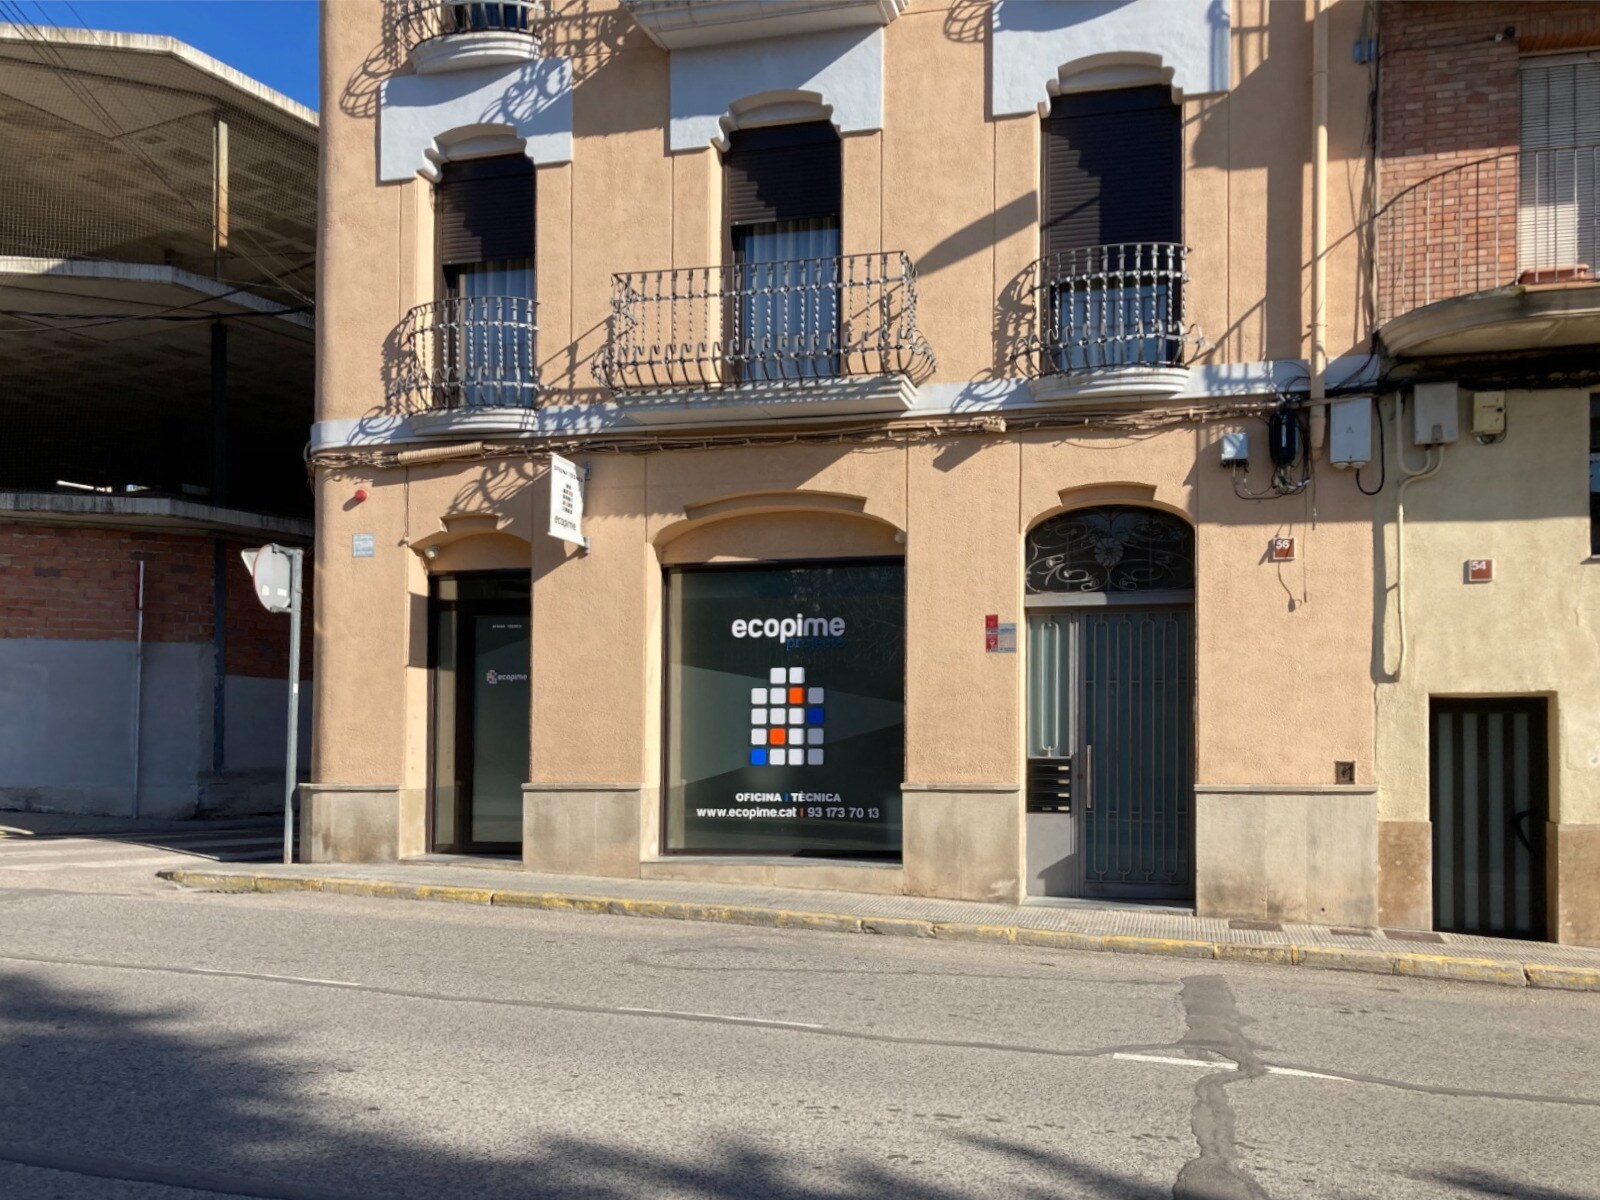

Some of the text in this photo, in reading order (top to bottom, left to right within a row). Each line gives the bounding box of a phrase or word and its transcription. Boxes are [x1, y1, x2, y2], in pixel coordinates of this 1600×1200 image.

[1275, 539, 1290, 550] 56
[1471, 560, 1486, 571] 54
[731, 613, 846, 644] ecopime
[497, 673, 528, 682] ecopime
[735, 790, 842, 803] OFICINA TÈCNICA
[696, 806, 880, 820] www.ecopime.cat 93 173 70 13
